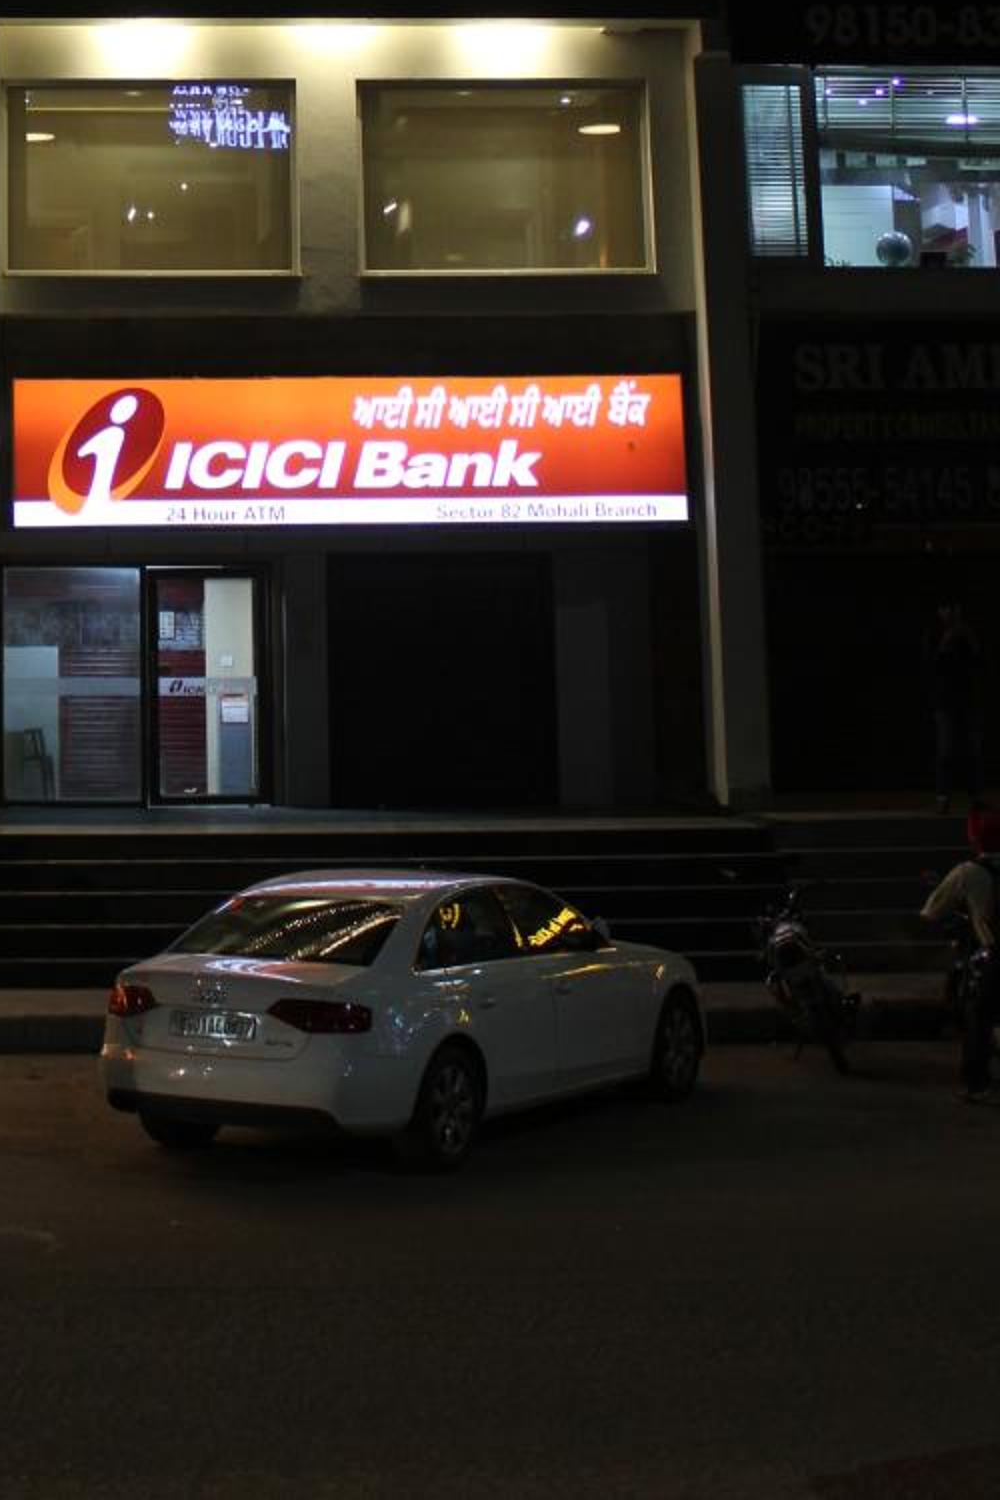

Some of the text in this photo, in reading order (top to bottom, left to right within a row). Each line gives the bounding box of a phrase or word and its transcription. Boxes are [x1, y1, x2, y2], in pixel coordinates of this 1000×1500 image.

[794, 342, 888, 390] SRI
[164, 438, 541, 490] ICICI Bank
[166, 505, 286, 522] 24 Hour ATM
[437, 501, 658, 519] Sector 82 Mohali Branch
